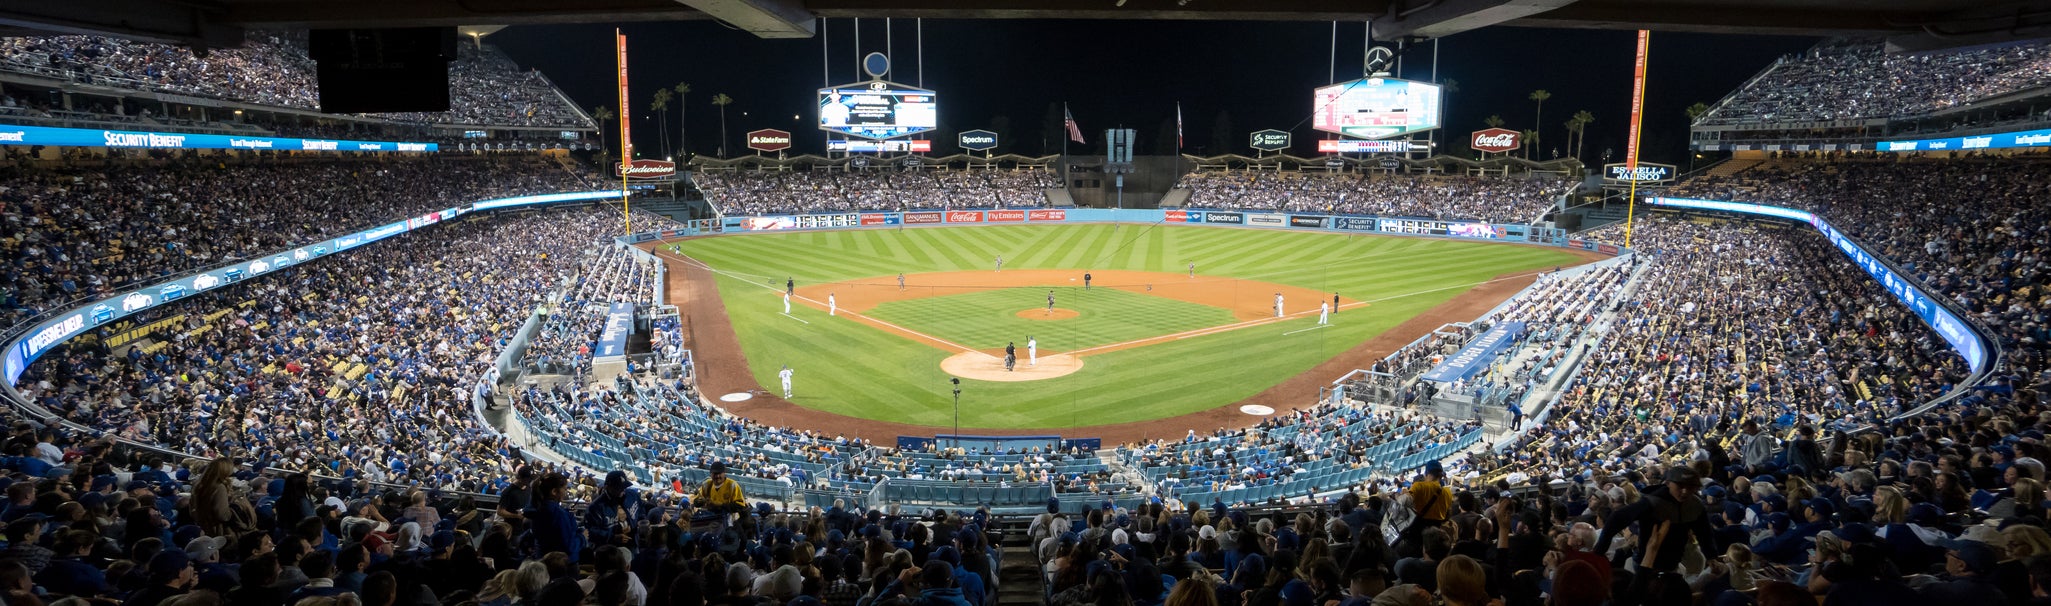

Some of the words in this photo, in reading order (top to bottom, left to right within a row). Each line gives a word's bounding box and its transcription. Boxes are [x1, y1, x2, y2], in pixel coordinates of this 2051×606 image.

[104, 131, 148, 146] SECURITY
[962, 136, 992, 144] Spectrum
[1475, 134, 1515, 147] Coca-Cola
[619, 165, 674, 174] Budweiser
[951, 212, 977, 222] Coca-Cola
[1207, 213, 1240, 222] Spectrum
[1448, 347, 1486, 368] DODGER
[1475, 329, 1509, 348] STADIUM
